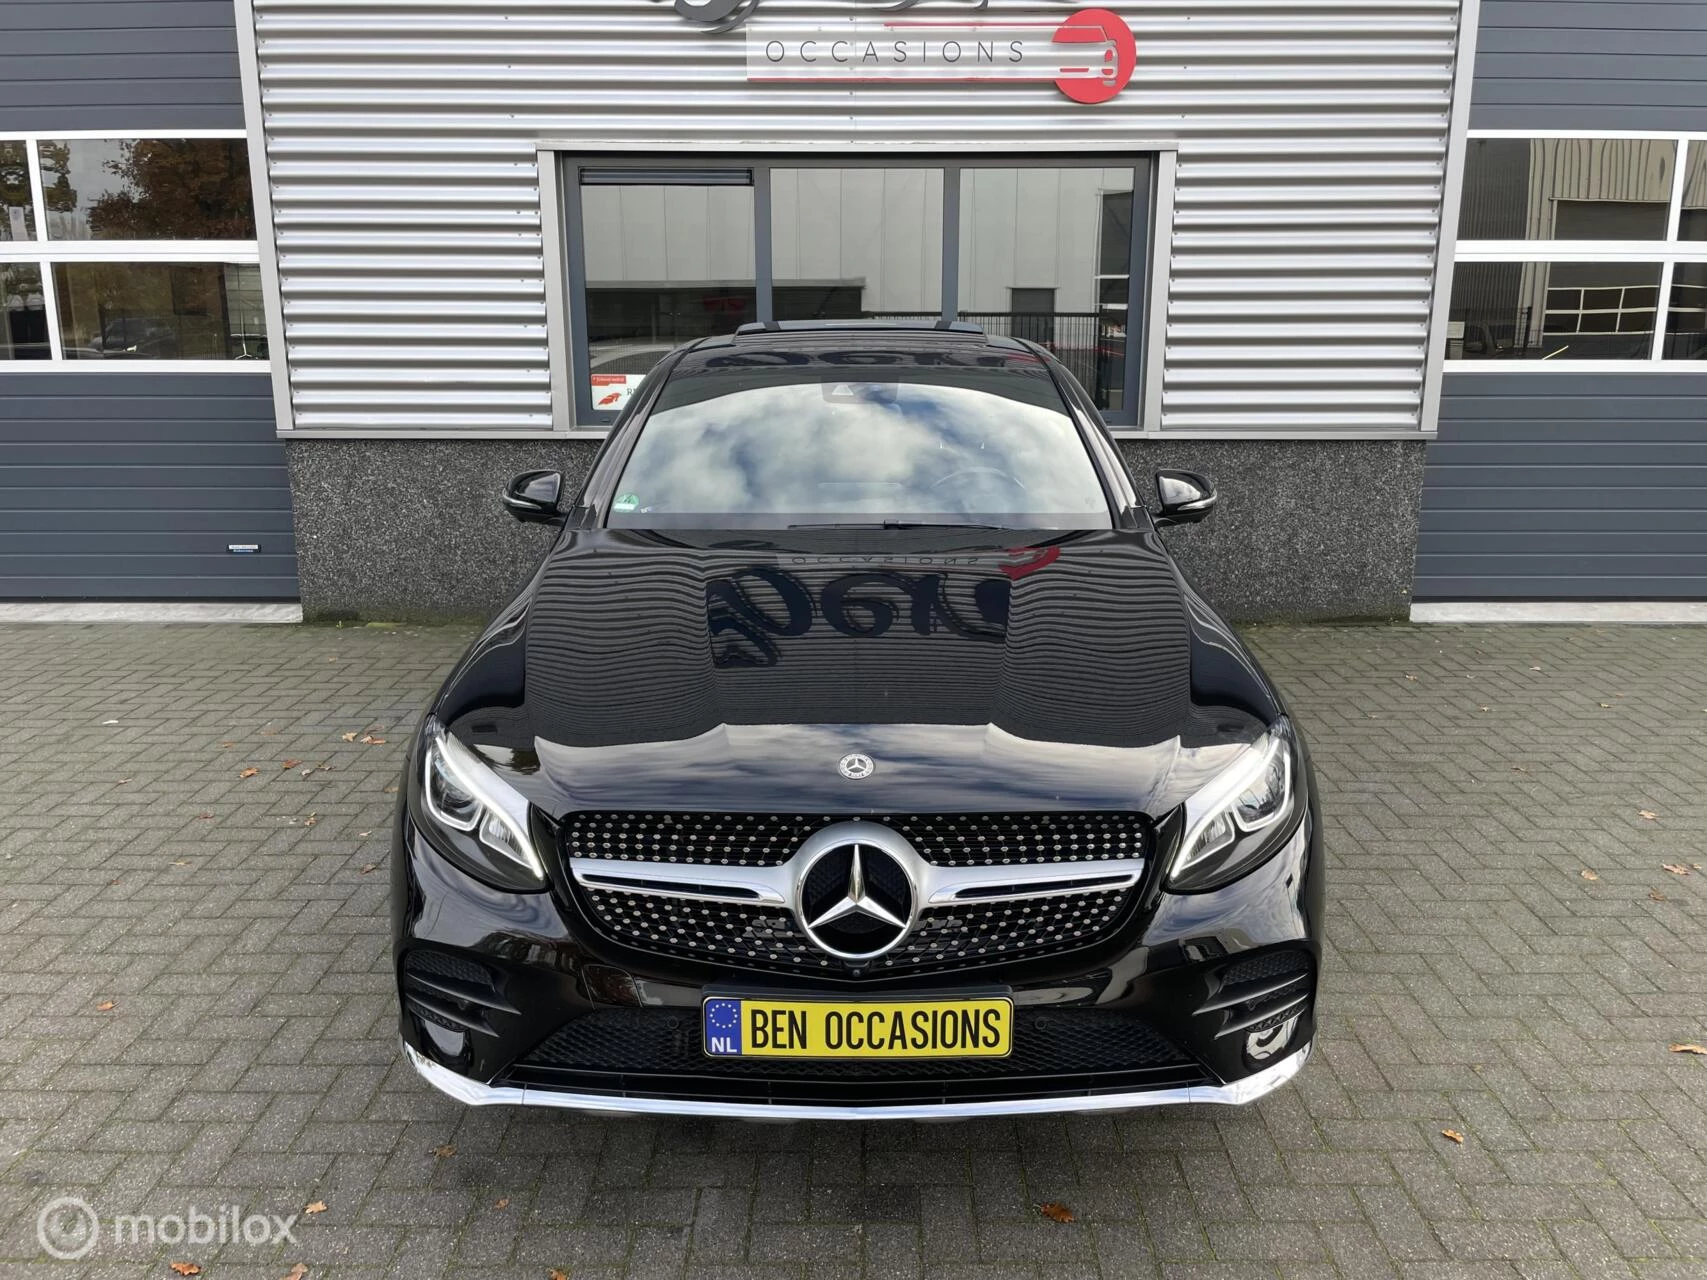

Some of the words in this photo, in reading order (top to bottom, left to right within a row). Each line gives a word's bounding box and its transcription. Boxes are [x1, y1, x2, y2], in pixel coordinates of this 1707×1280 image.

[765, 40, 1023, 63] OCCASIONS
[751, 1009, 807, 1050] BEN
[825, 1009, 1001, 1050] OCCASIONS
[711, 1037, 737, 1053] NL
